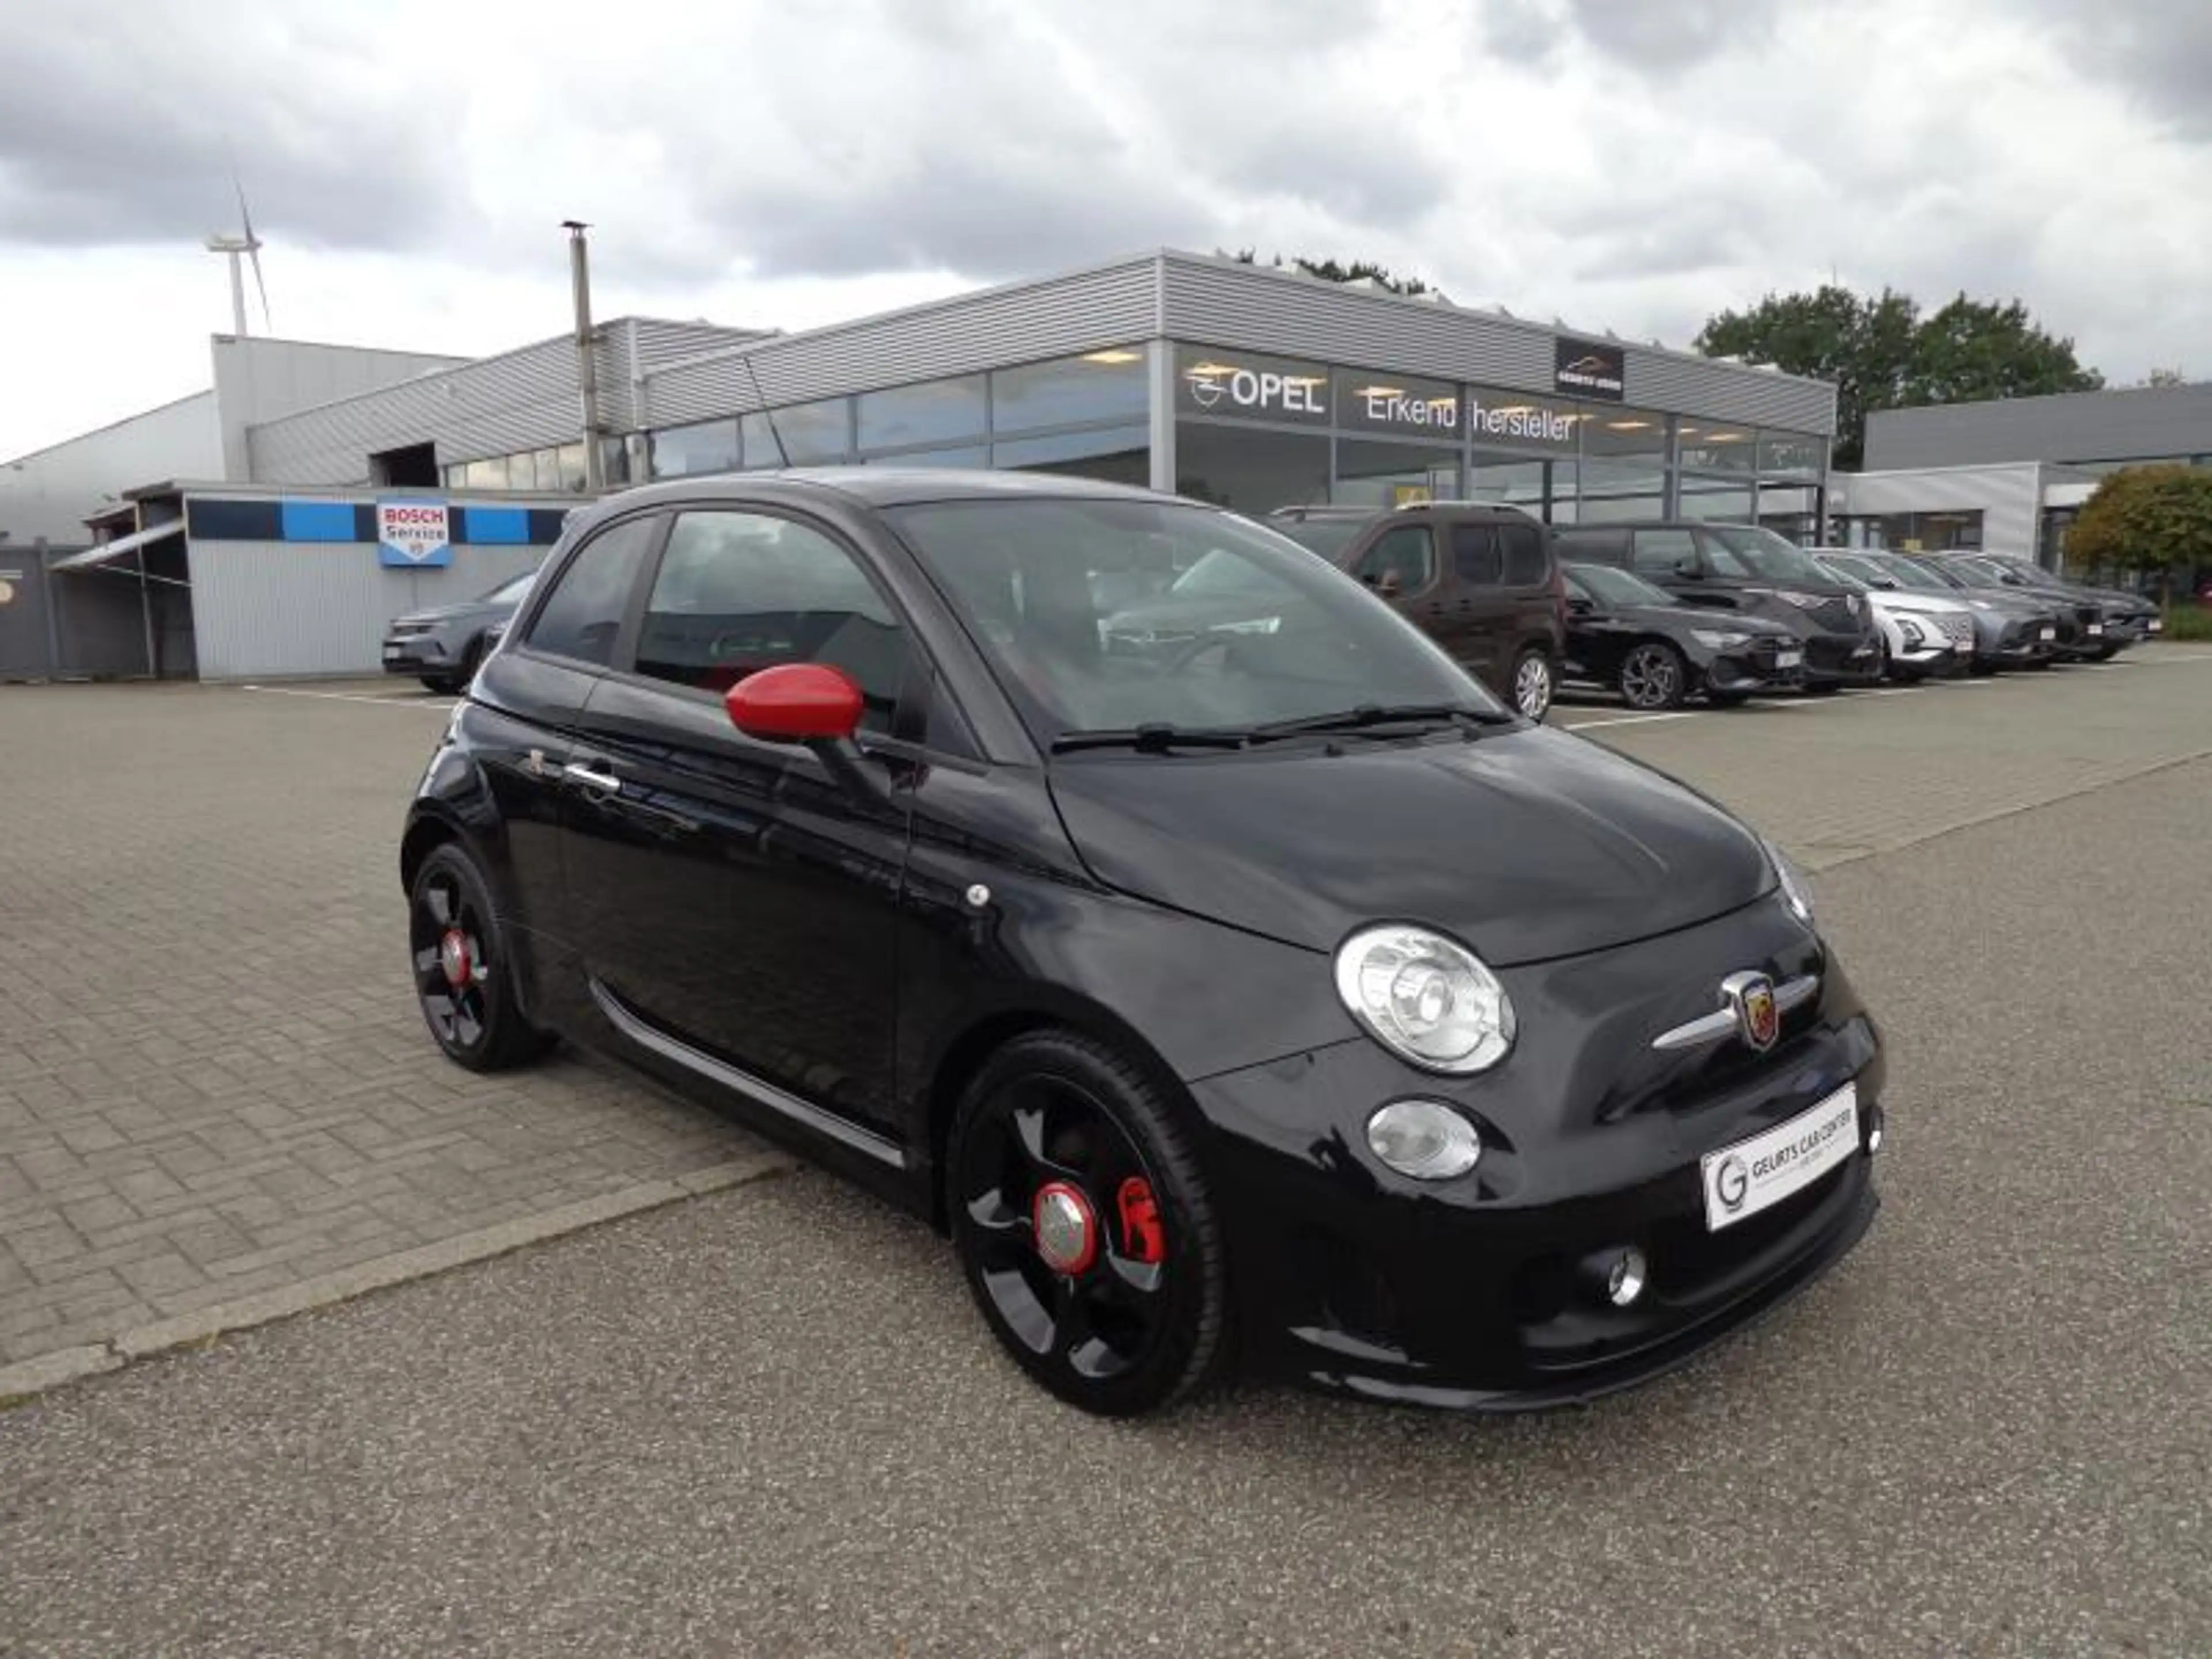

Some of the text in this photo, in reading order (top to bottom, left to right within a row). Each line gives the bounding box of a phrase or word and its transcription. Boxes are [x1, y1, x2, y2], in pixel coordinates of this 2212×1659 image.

[1232, 369, 1325, 414] OPEL
[1367, 387, 1573, 441] Erkend hersteller
[384, 508, 444, 524] BOSCH
[387, 525, 445, 540] Service
[1752, 1142, 1799, 1178] GEURTS
